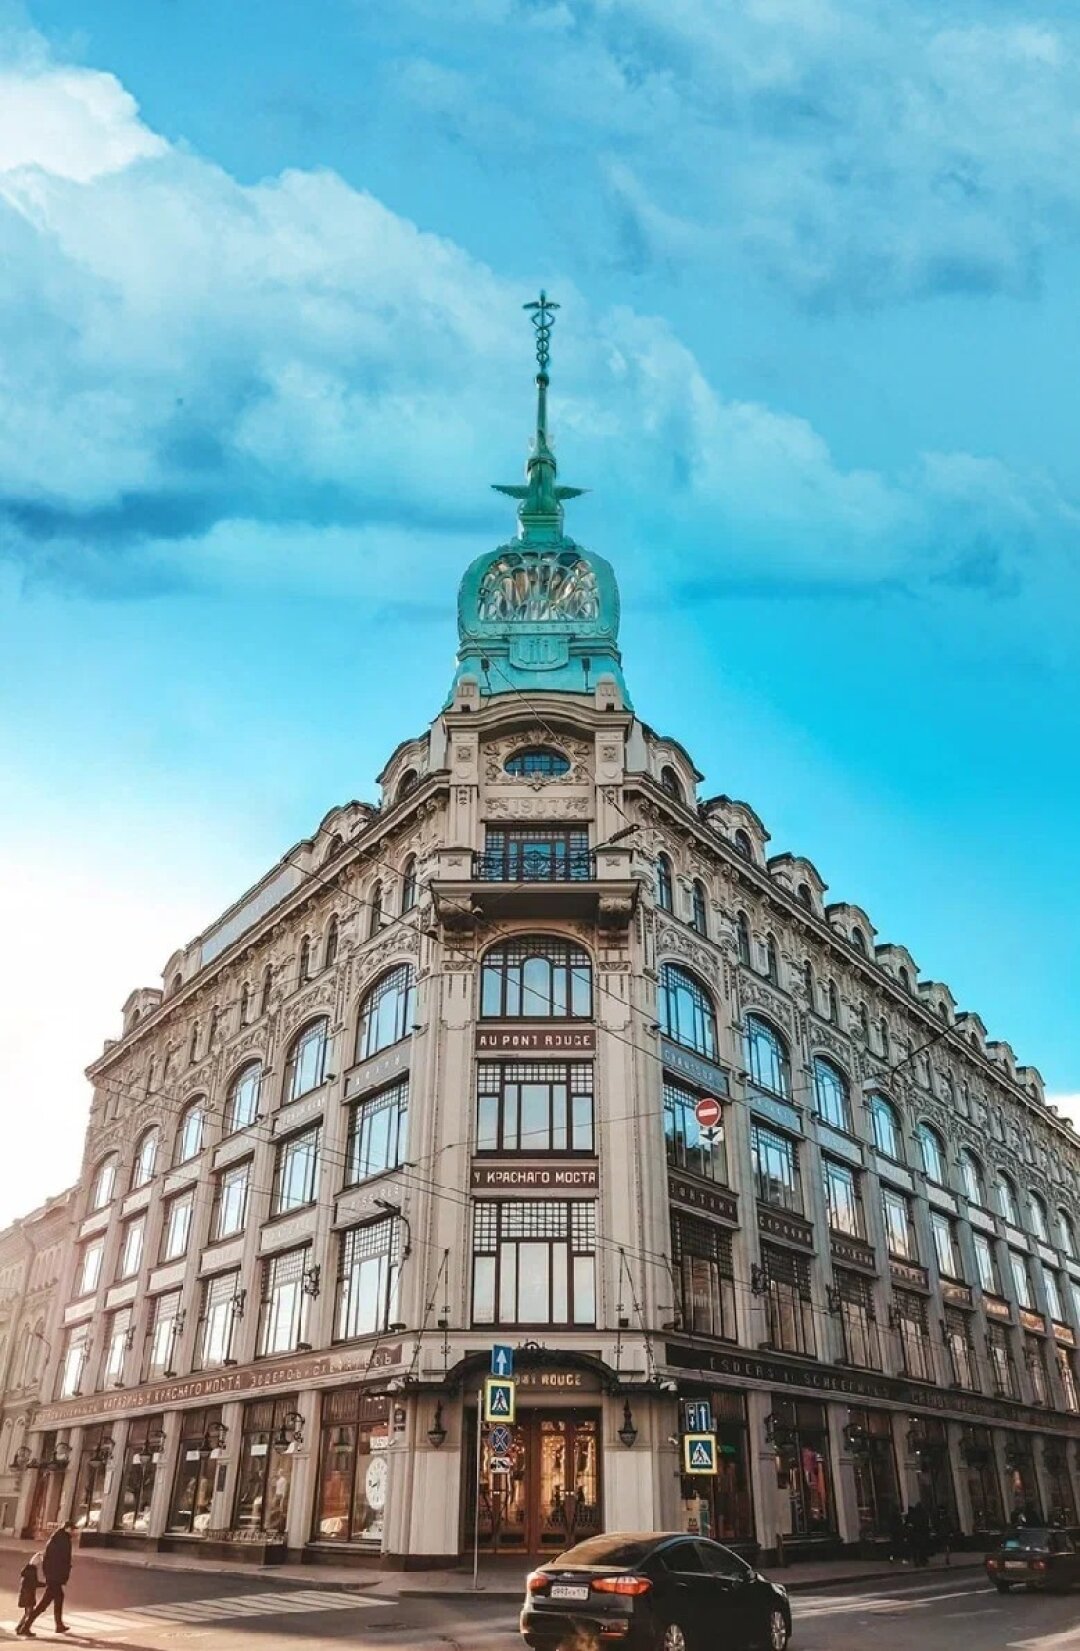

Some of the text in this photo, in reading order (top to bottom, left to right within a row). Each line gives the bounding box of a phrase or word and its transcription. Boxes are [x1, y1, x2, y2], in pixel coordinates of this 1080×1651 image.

[479, 1035, 591, 1046] AU PONT ROUGE
[487, 1171, 549, 1183] КРАСНАГО
[555, 1171, 596, 1183] МОСТА
[541, 1373, 582, 1386] ROUGE
[154, 1383, 202, 1401] КРАСНАГО
[205, 1375, 241, 1393] МОСТА
